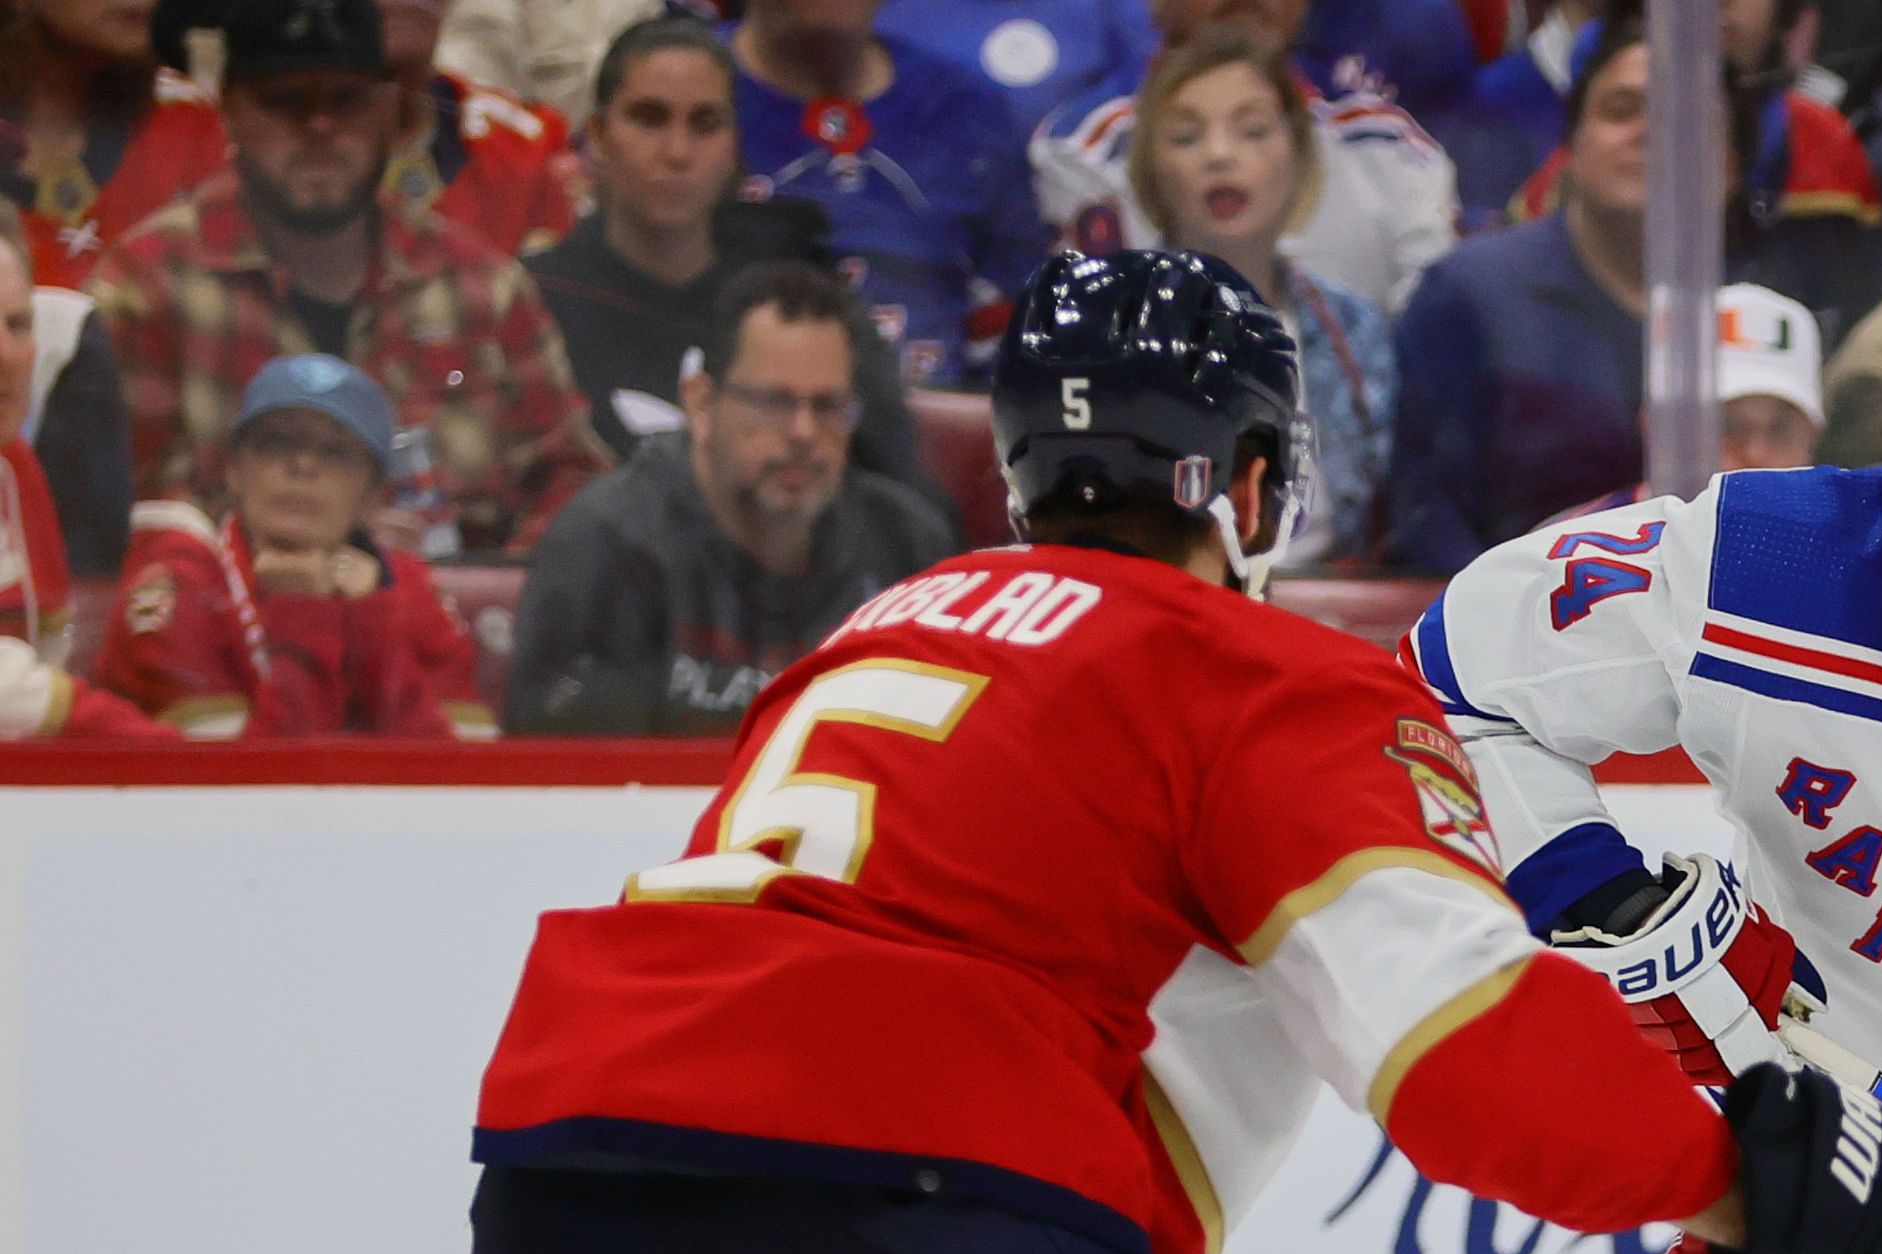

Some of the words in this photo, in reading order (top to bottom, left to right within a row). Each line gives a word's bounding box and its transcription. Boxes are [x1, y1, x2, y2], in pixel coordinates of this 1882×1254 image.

[1061, 377, 1093, 430] 5
[1547, 520, 1667, 632] 24
[624, 656, 991, 905] 5
